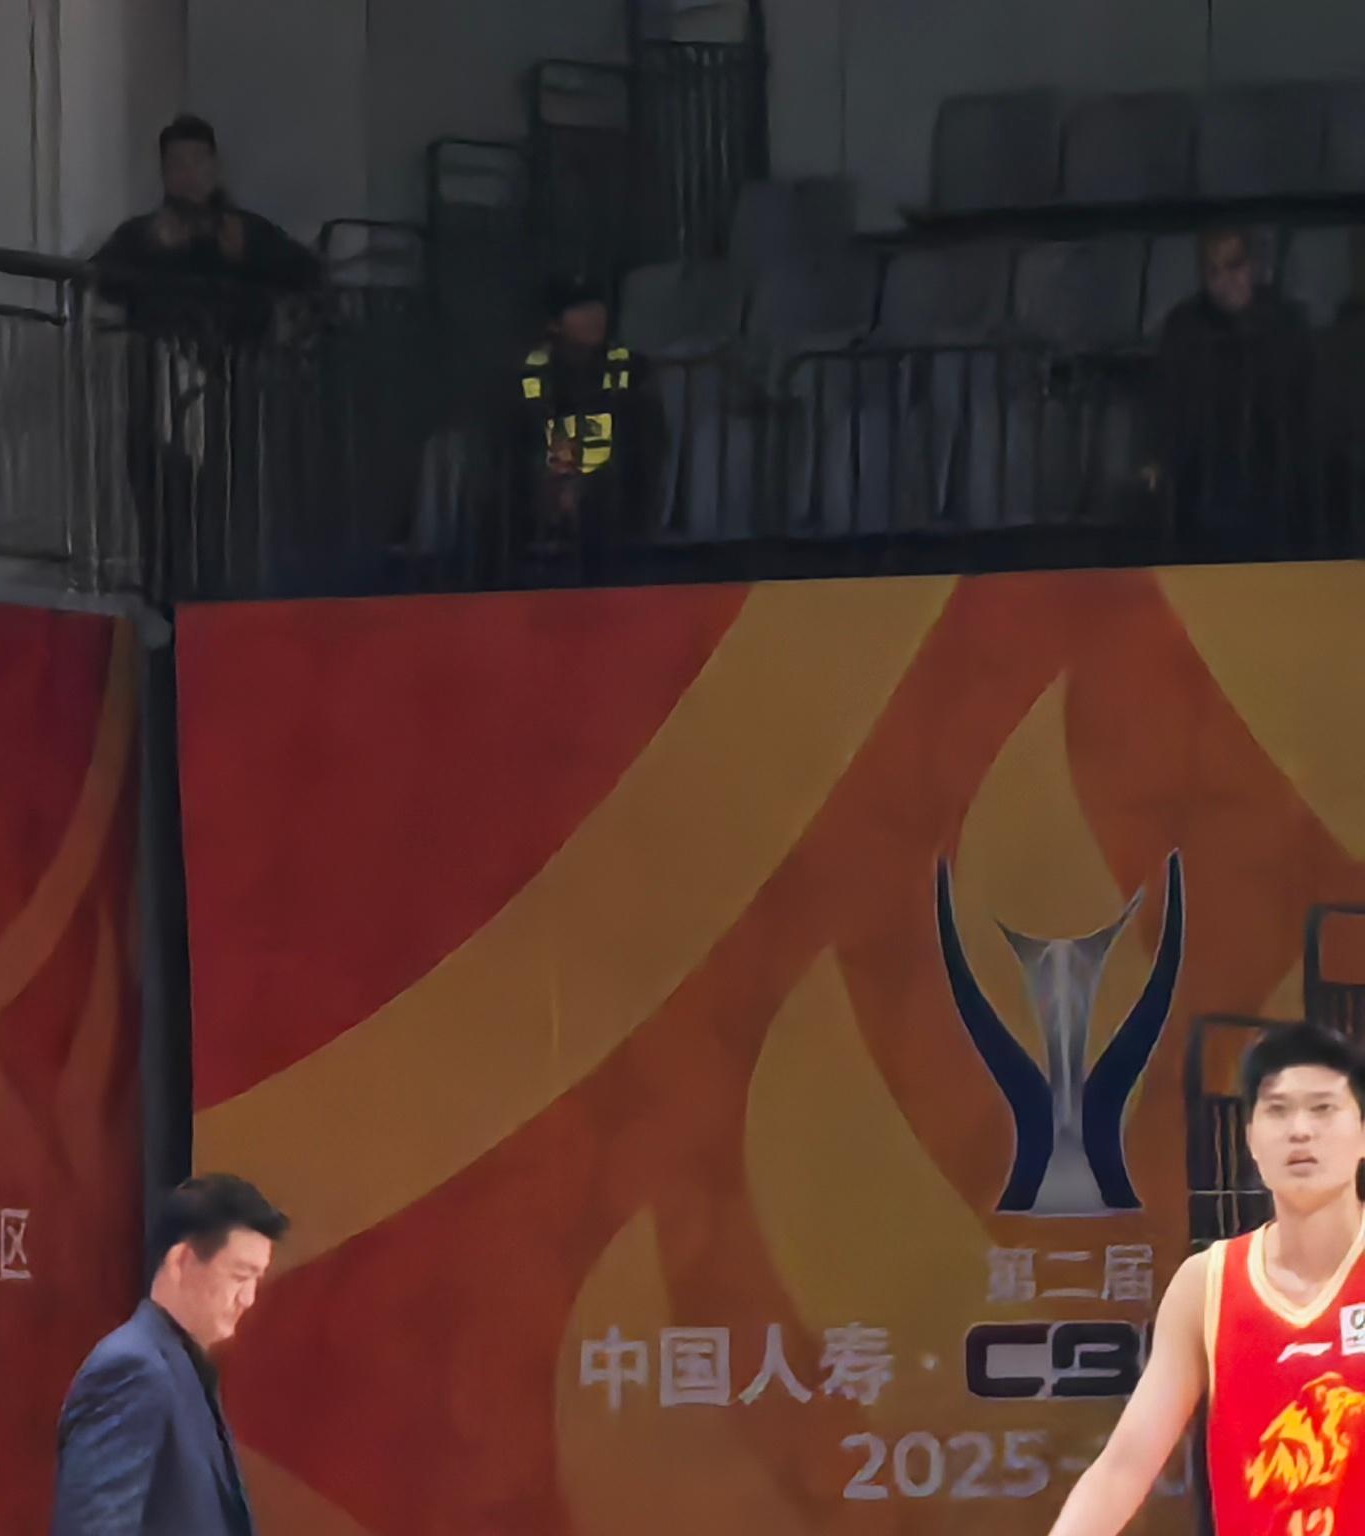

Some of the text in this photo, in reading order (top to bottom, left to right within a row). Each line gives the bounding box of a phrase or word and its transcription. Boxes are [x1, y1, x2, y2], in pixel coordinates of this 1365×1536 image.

[987, 1244, 1153, 1301] 第二届
[965, 1320, 1149, 1399] CB
